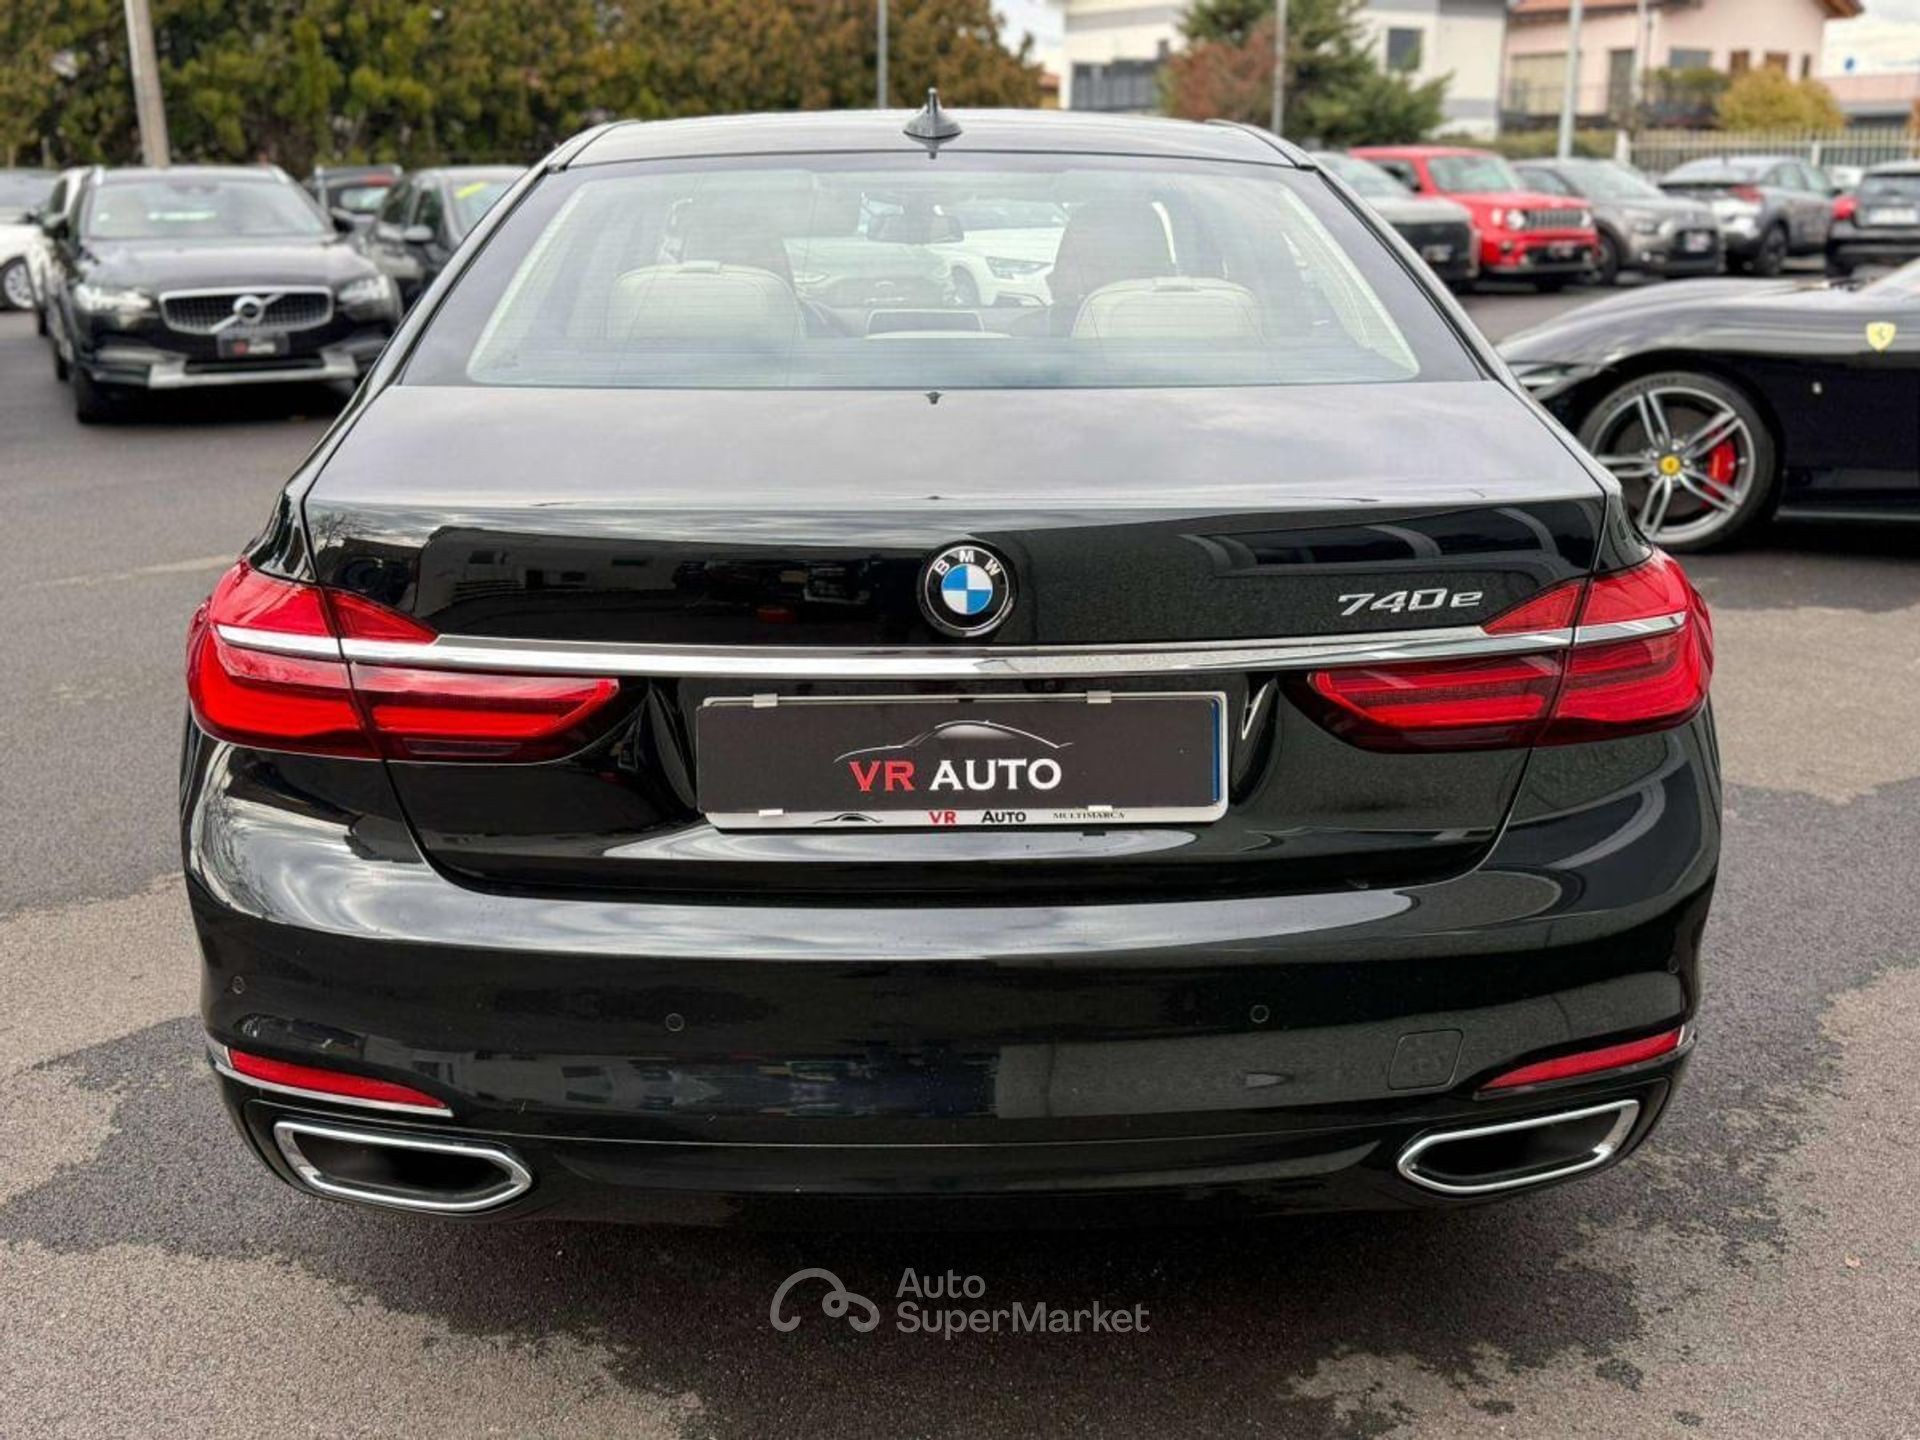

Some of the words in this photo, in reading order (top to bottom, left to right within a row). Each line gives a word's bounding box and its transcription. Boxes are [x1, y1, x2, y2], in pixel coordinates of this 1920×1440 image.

[933, 550, 1001, 576] BMW
[1337, 588, 1484, 616] 740e
[849, 760, 916, 792] VR
[928, 758, 1063, 791] AUTO
[928, 811, 958, 824] VR
[1052, 809, 1126, 820] MULTIMARCA
